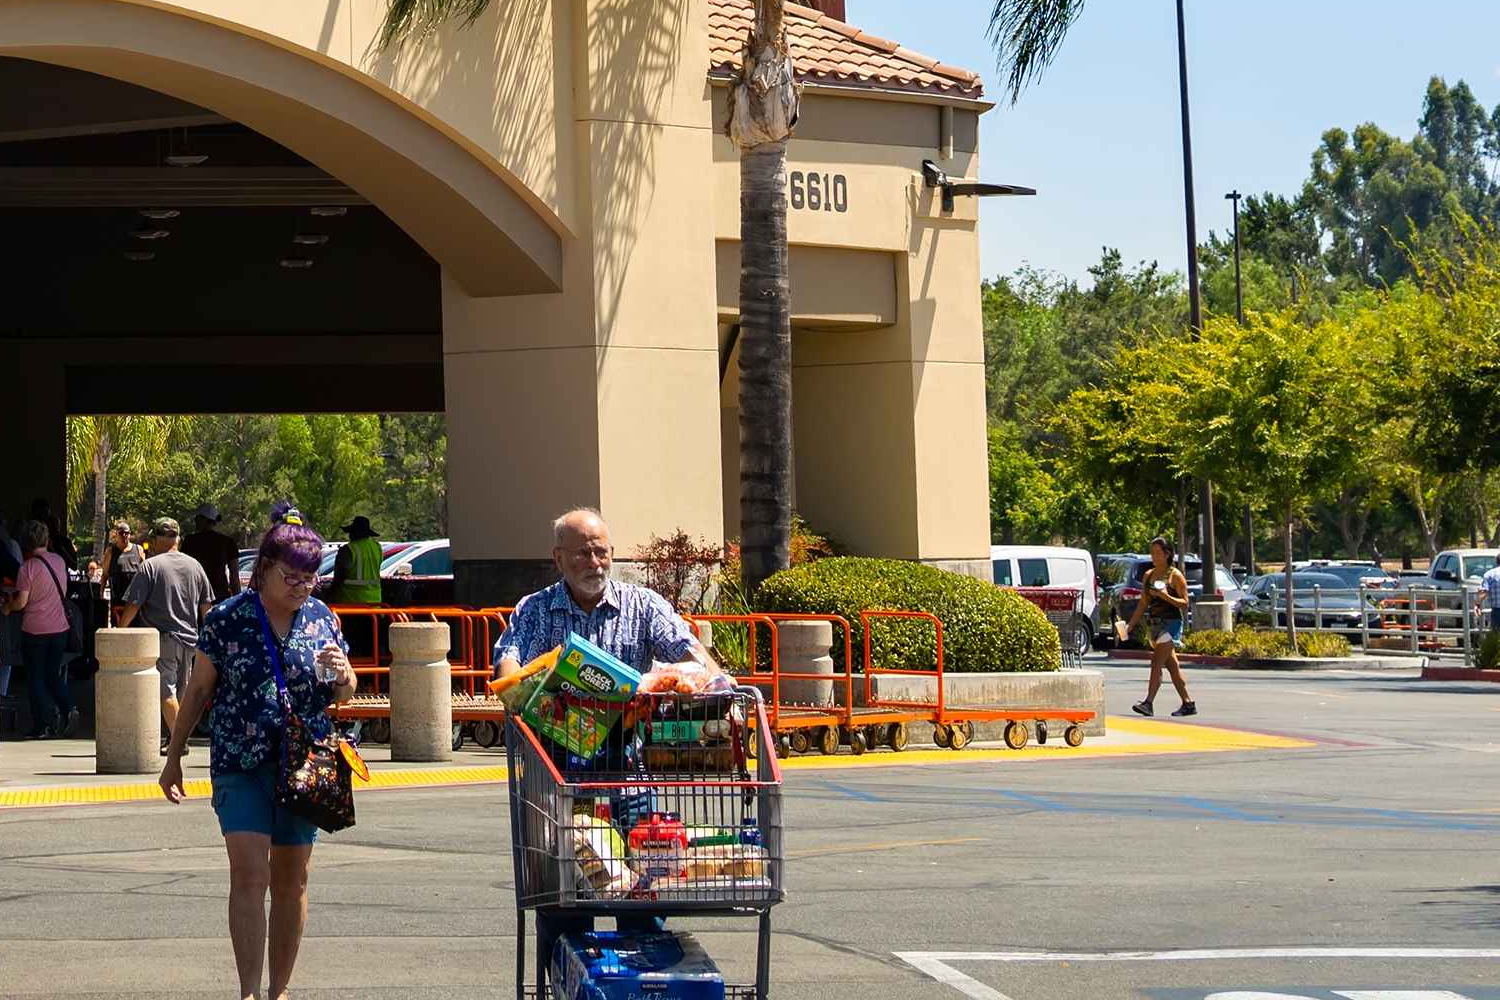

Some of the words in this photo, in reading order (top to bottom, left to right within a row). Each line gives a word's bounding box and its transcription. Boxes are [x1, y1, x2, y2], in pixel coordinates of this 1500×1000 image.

[784, 171, 848, 213] 6610
[580, 672, 612, 692] FOREST
[585, 666, 612, 687] BLACK
